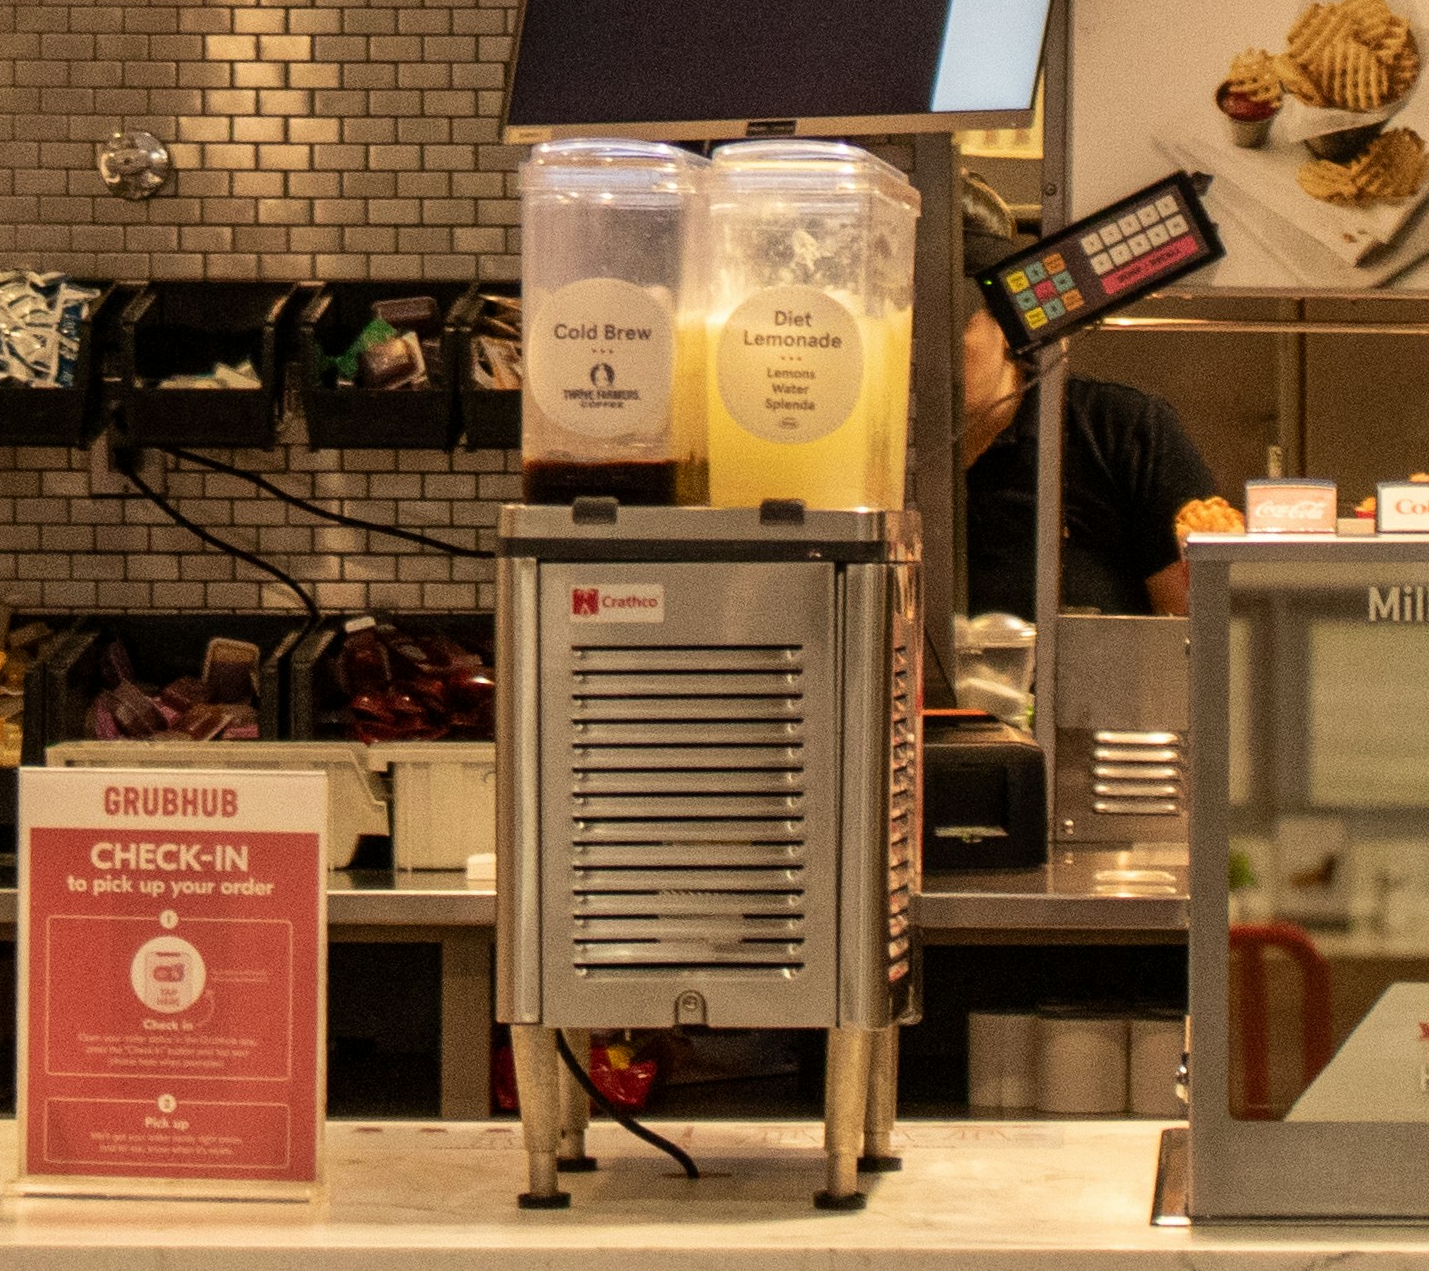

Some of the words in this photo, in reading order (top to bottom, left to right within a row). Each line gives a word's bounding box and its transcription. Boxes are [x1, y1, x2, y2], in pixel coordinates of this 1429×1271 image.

[774, 310, 812, 327] Diet
[555, 324, 597, 340] Cold
[605, 325, 651, 340] Brew
[744, 331, 842, 348] Lemonade
[767, 367, 815, 379] Lemons
[772, 384, 808, 394] Water
[765, 398, 815, 411] Splenda
[1255, 500, 1326, 521] Coca-Cola
[603, 596, 658, 608] Crathco
[104, 787, 238, 817] GRUBHUB
[91, 843, 248, 871] CHECK-IN
[67, 878, 87, 892] to
[93, 876, 132, 895] pick
[141, 880, 164, 895] up
[171, 881, 214, 895] your
[221, 880, 273, 896] order
